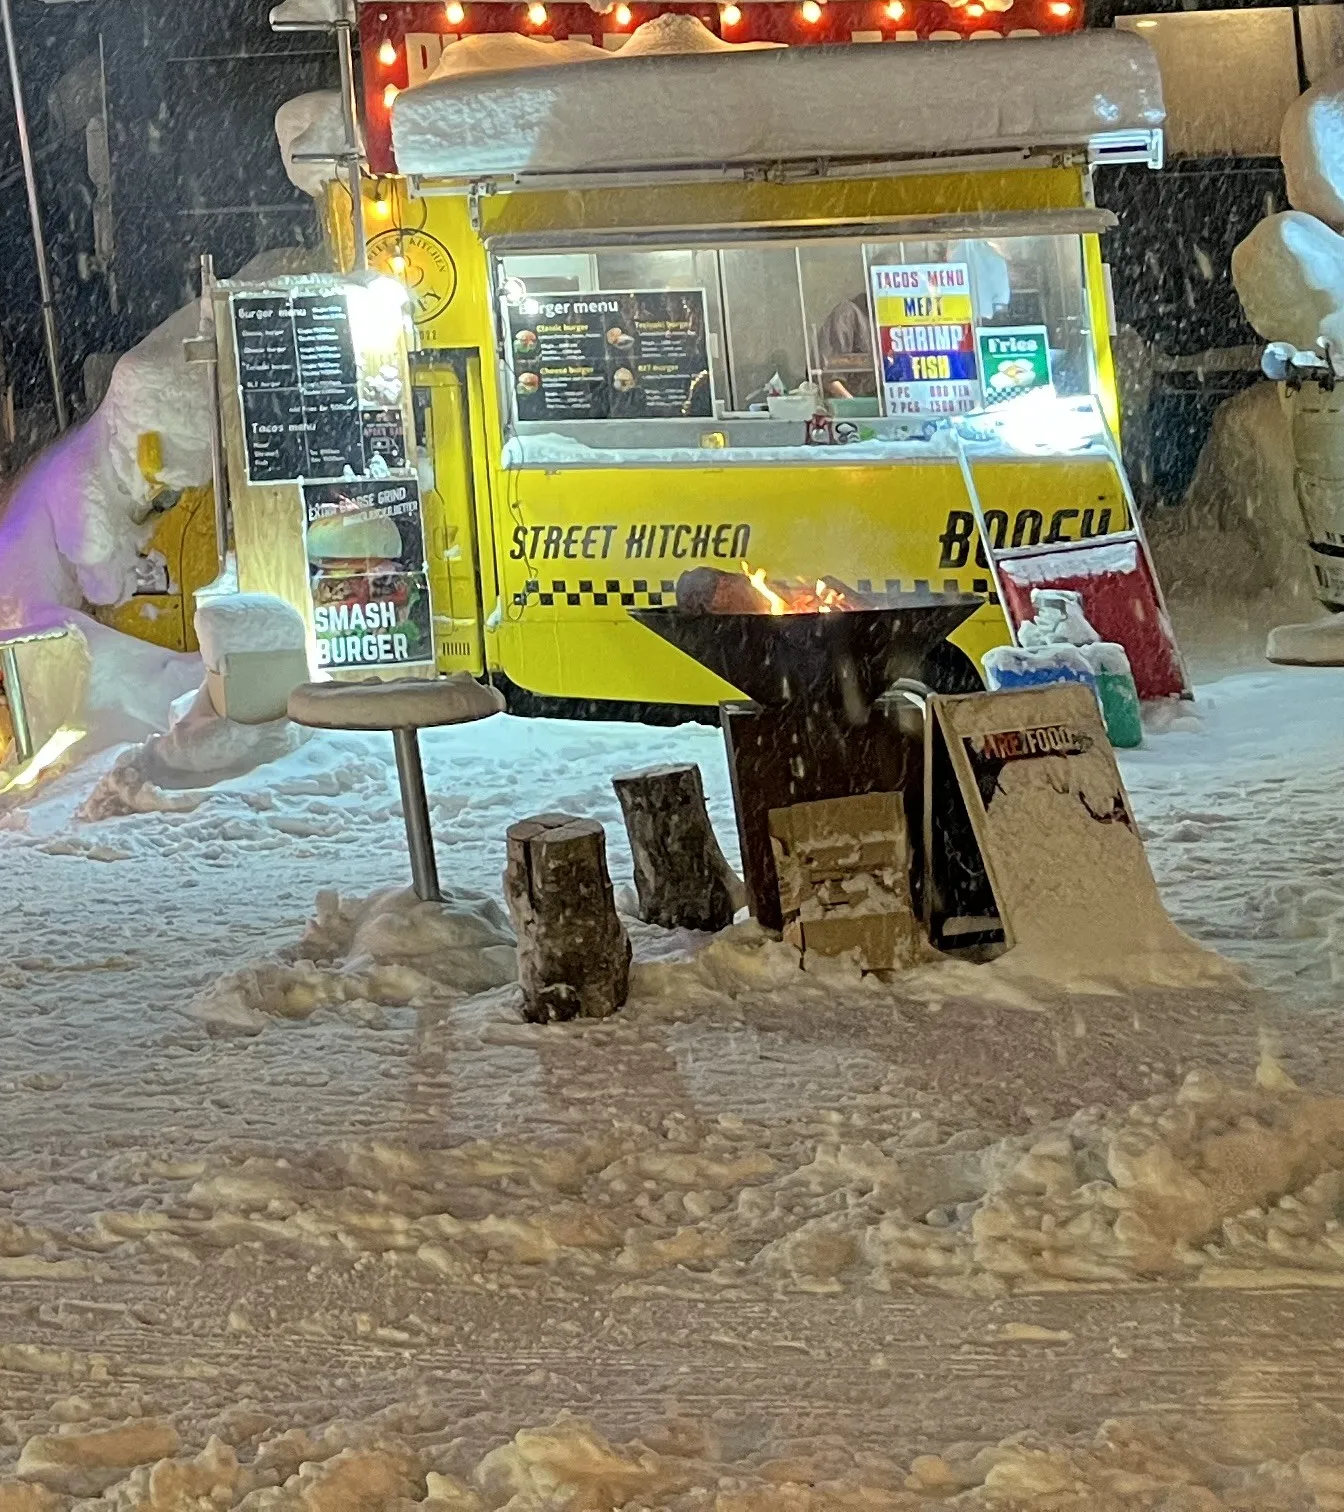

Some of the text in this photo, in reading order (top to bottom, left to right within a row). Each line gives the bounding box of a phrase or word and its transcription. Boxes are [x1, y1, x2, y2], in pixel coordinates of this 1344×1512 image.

[876, 269, 965, 288] TACOS MENU
[573, 300, 620, 315] menu
[889, 325, 963, 353] SHRIMP
[988, 336, 1038, 353] Fries
[911, 354, 950, 380] FISH
[509, 523, 751, 560] STREET KITCHEN
[315, 601, 397, 633] SMASH
[316, 633, 409, 665] BURGER
